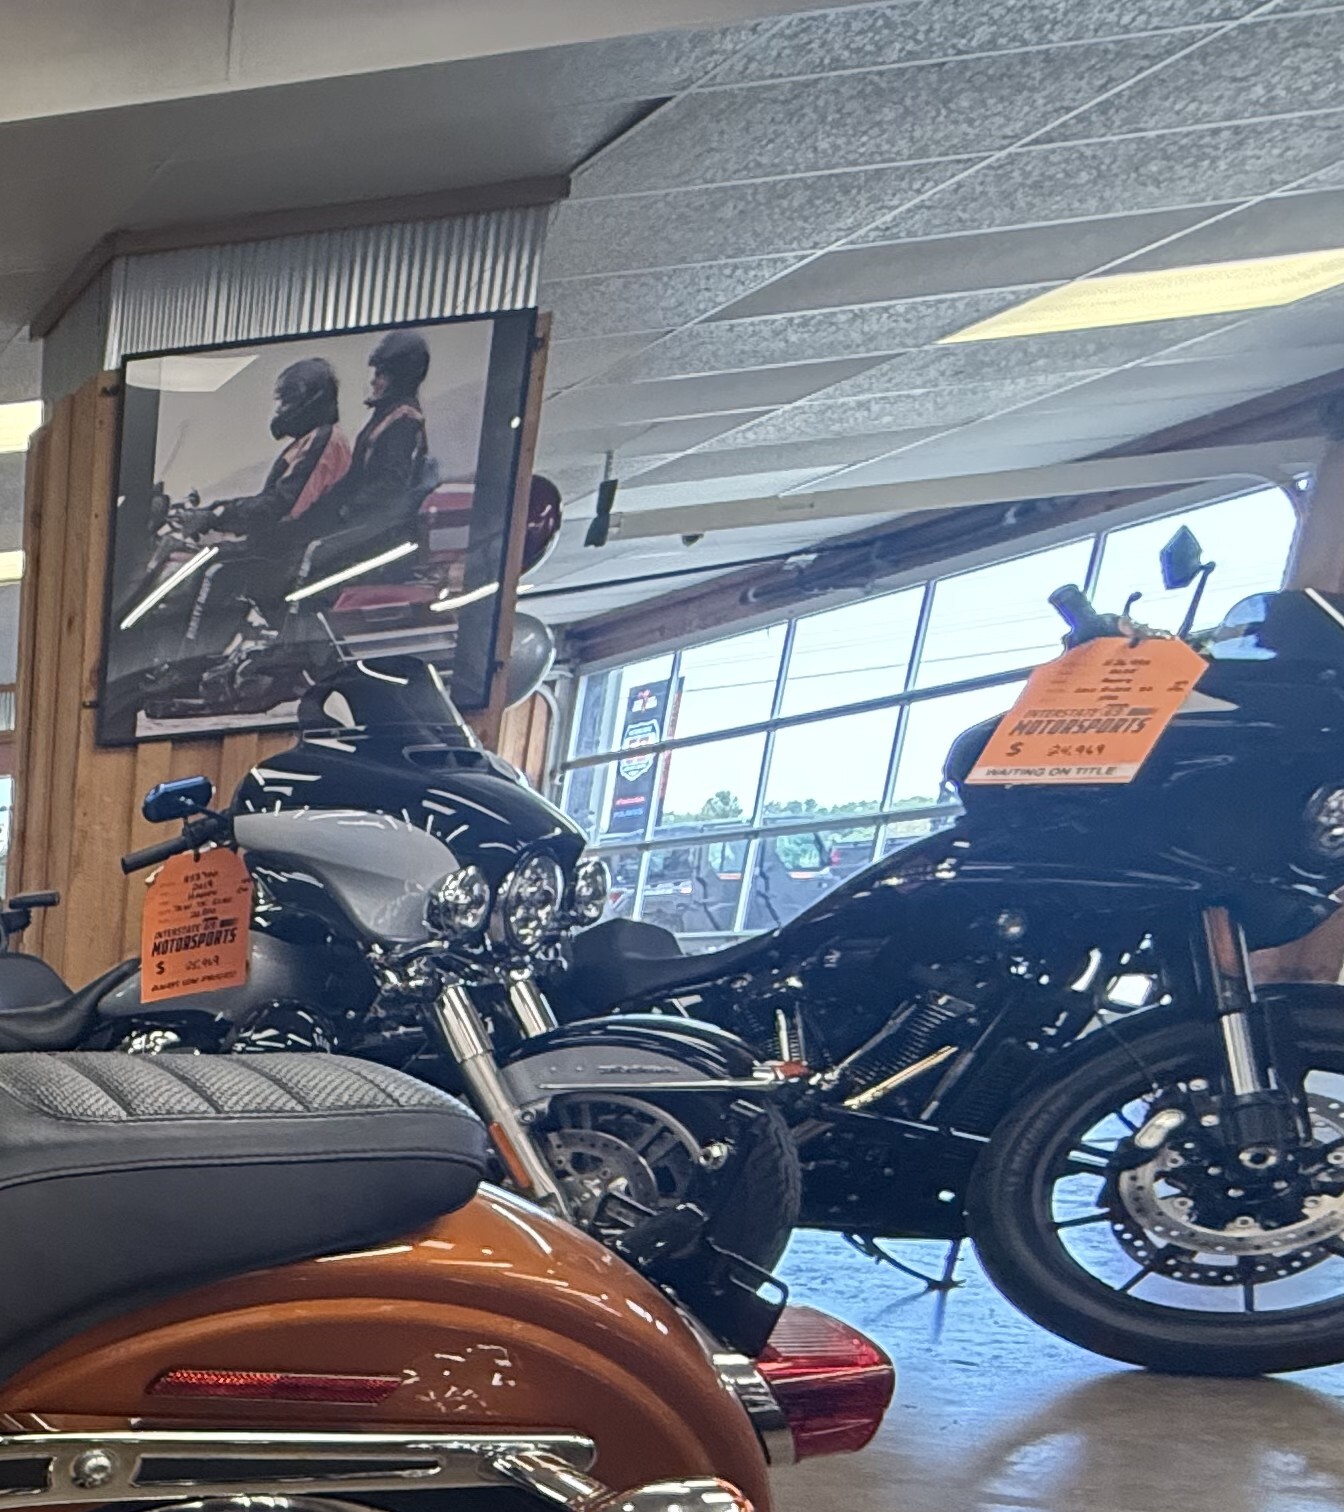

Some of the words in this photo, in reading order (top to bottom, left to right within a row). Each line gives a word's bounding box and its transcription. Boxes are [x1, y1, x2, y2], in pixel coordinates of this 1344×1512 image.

[1008, 717, 1153, 736] MOTORSPORTS
[1006, 742, 1024, 757] $
[985, 767, 1046, 777] WAITING
[1048, 767, 1073, 776] ON
[1075, 766, 1118, 776] TITLE
[152, 927, 238, 957] MOTORSPORTS
[155, 961, 165, 975] $
